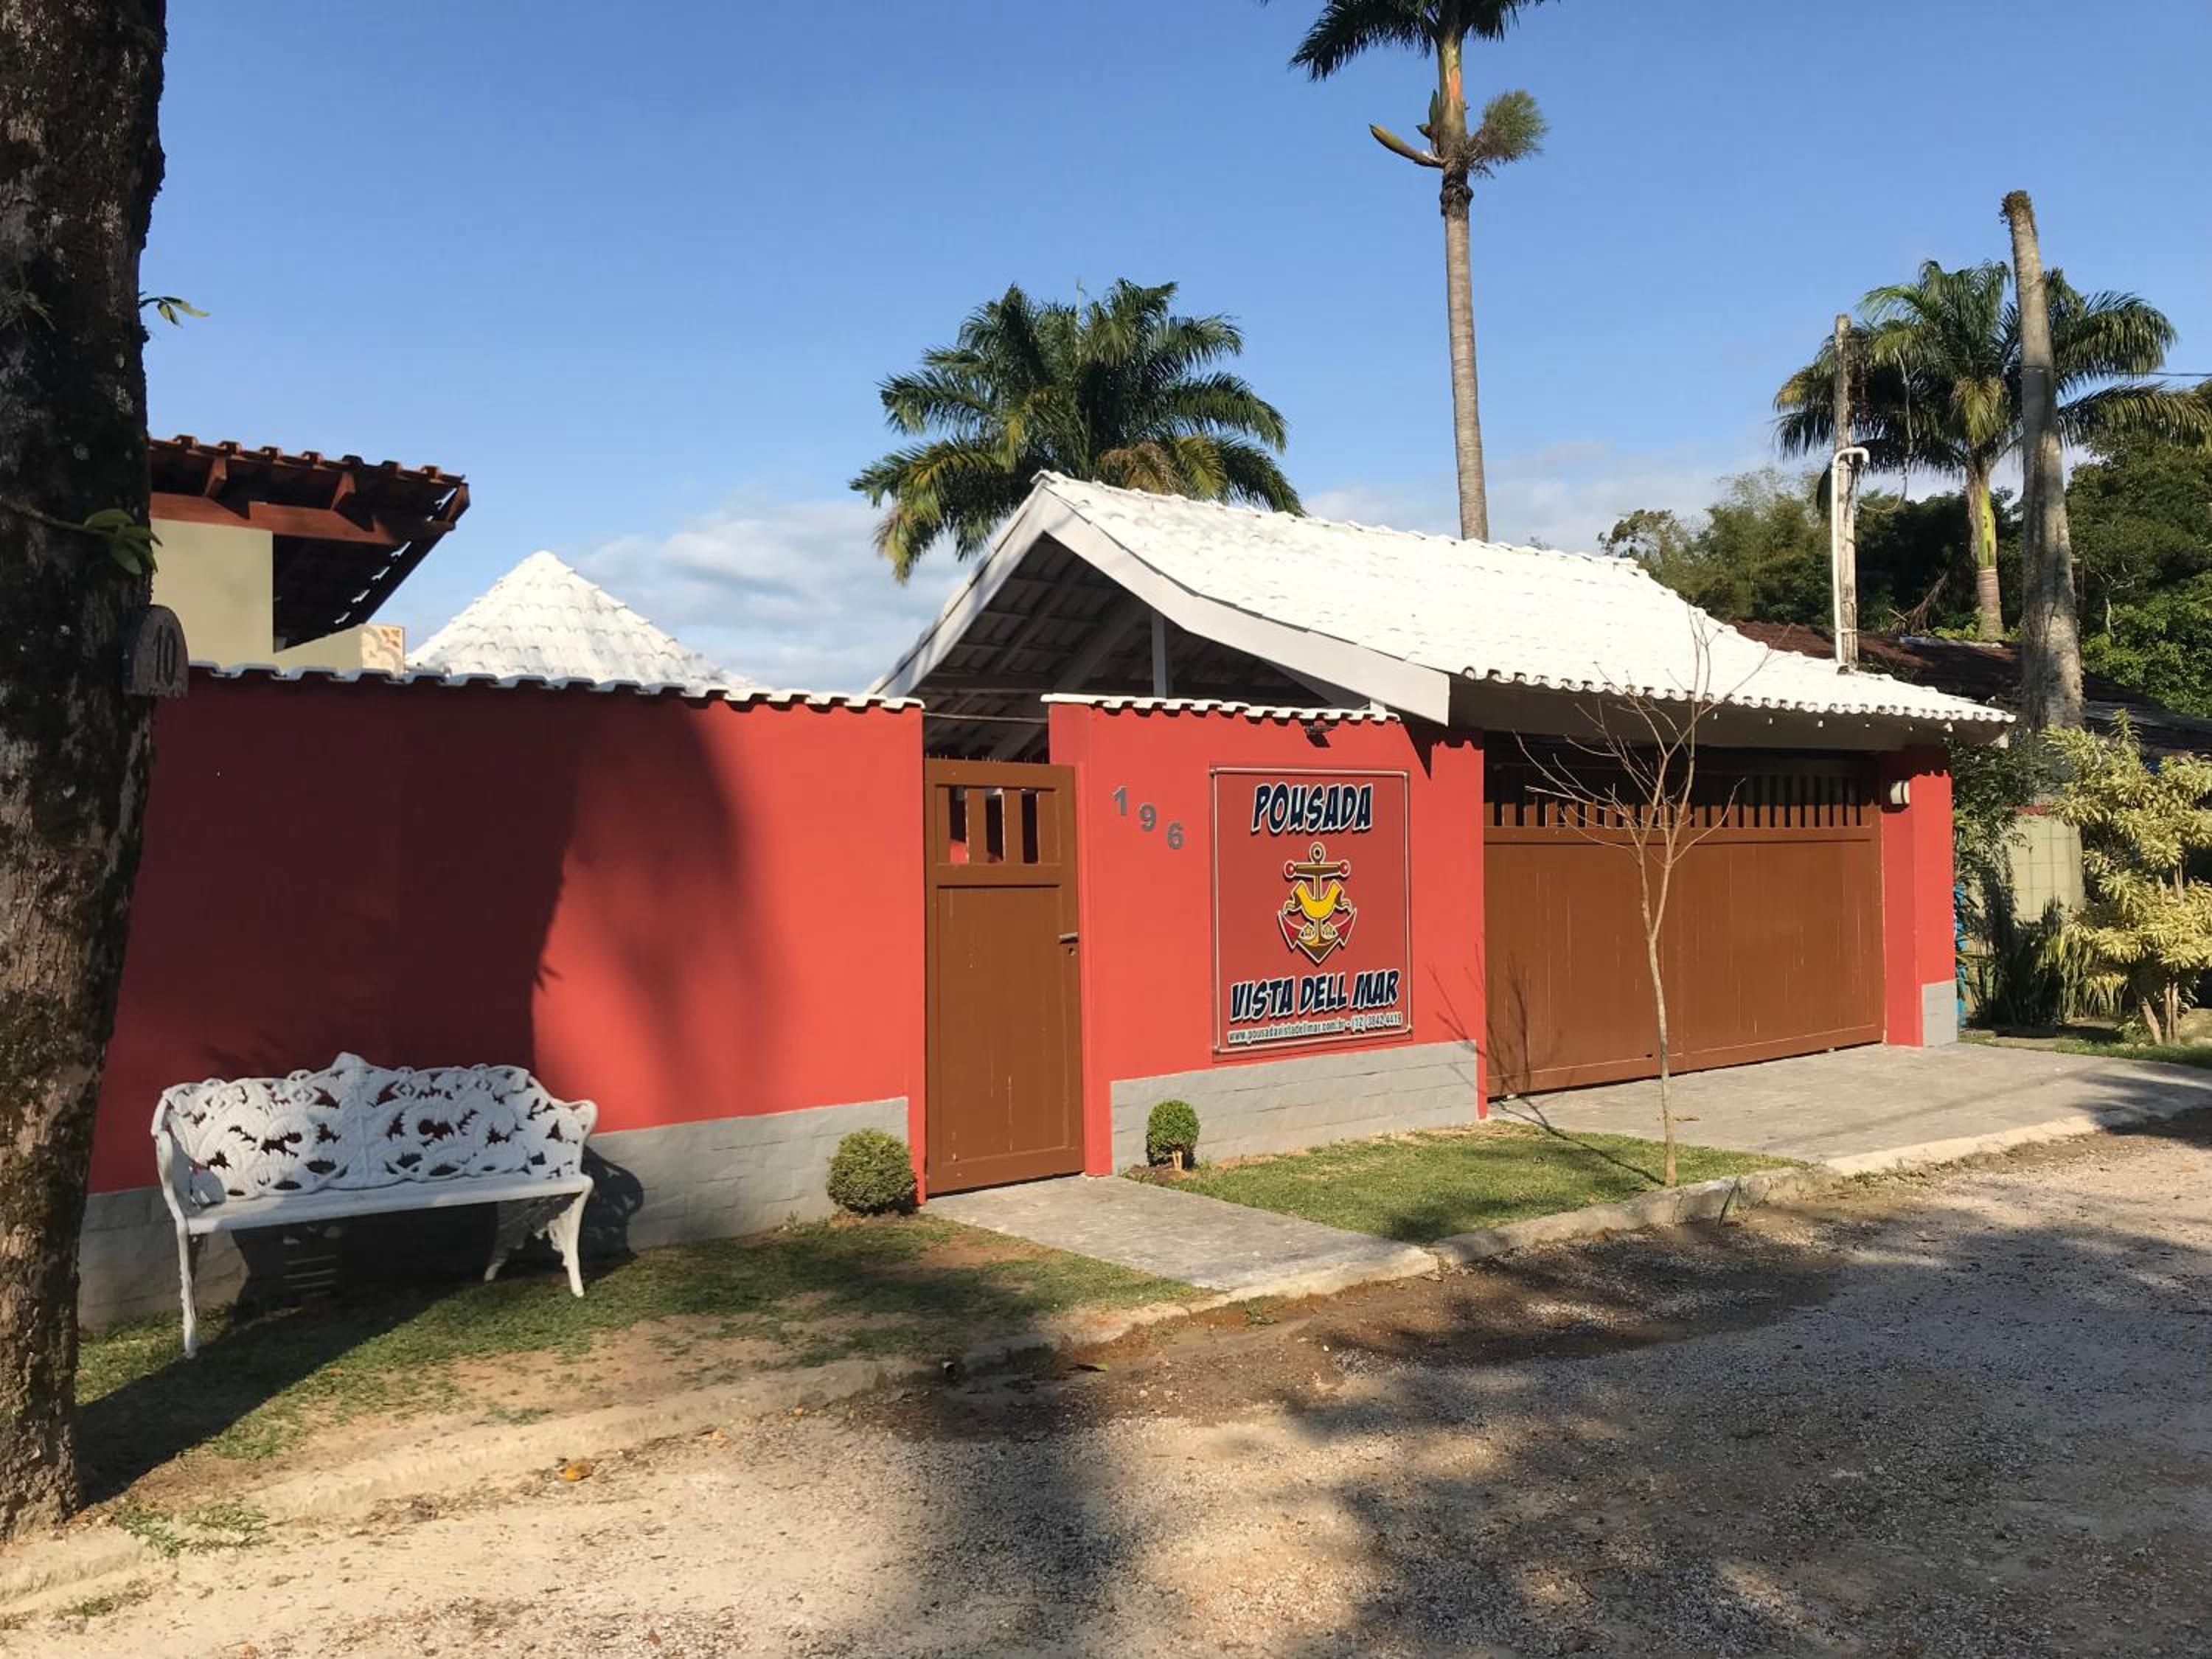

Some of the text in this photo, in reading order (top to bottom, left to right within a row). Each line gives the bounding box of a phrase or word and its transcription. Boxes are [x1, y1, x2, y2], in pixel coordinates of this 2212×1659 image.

[1112, 785, 1184, 850] 196
[1251, 782, 1373, 834] POUSADA
[1230, 969, 1400, 1020] VISTA DELL MAR
